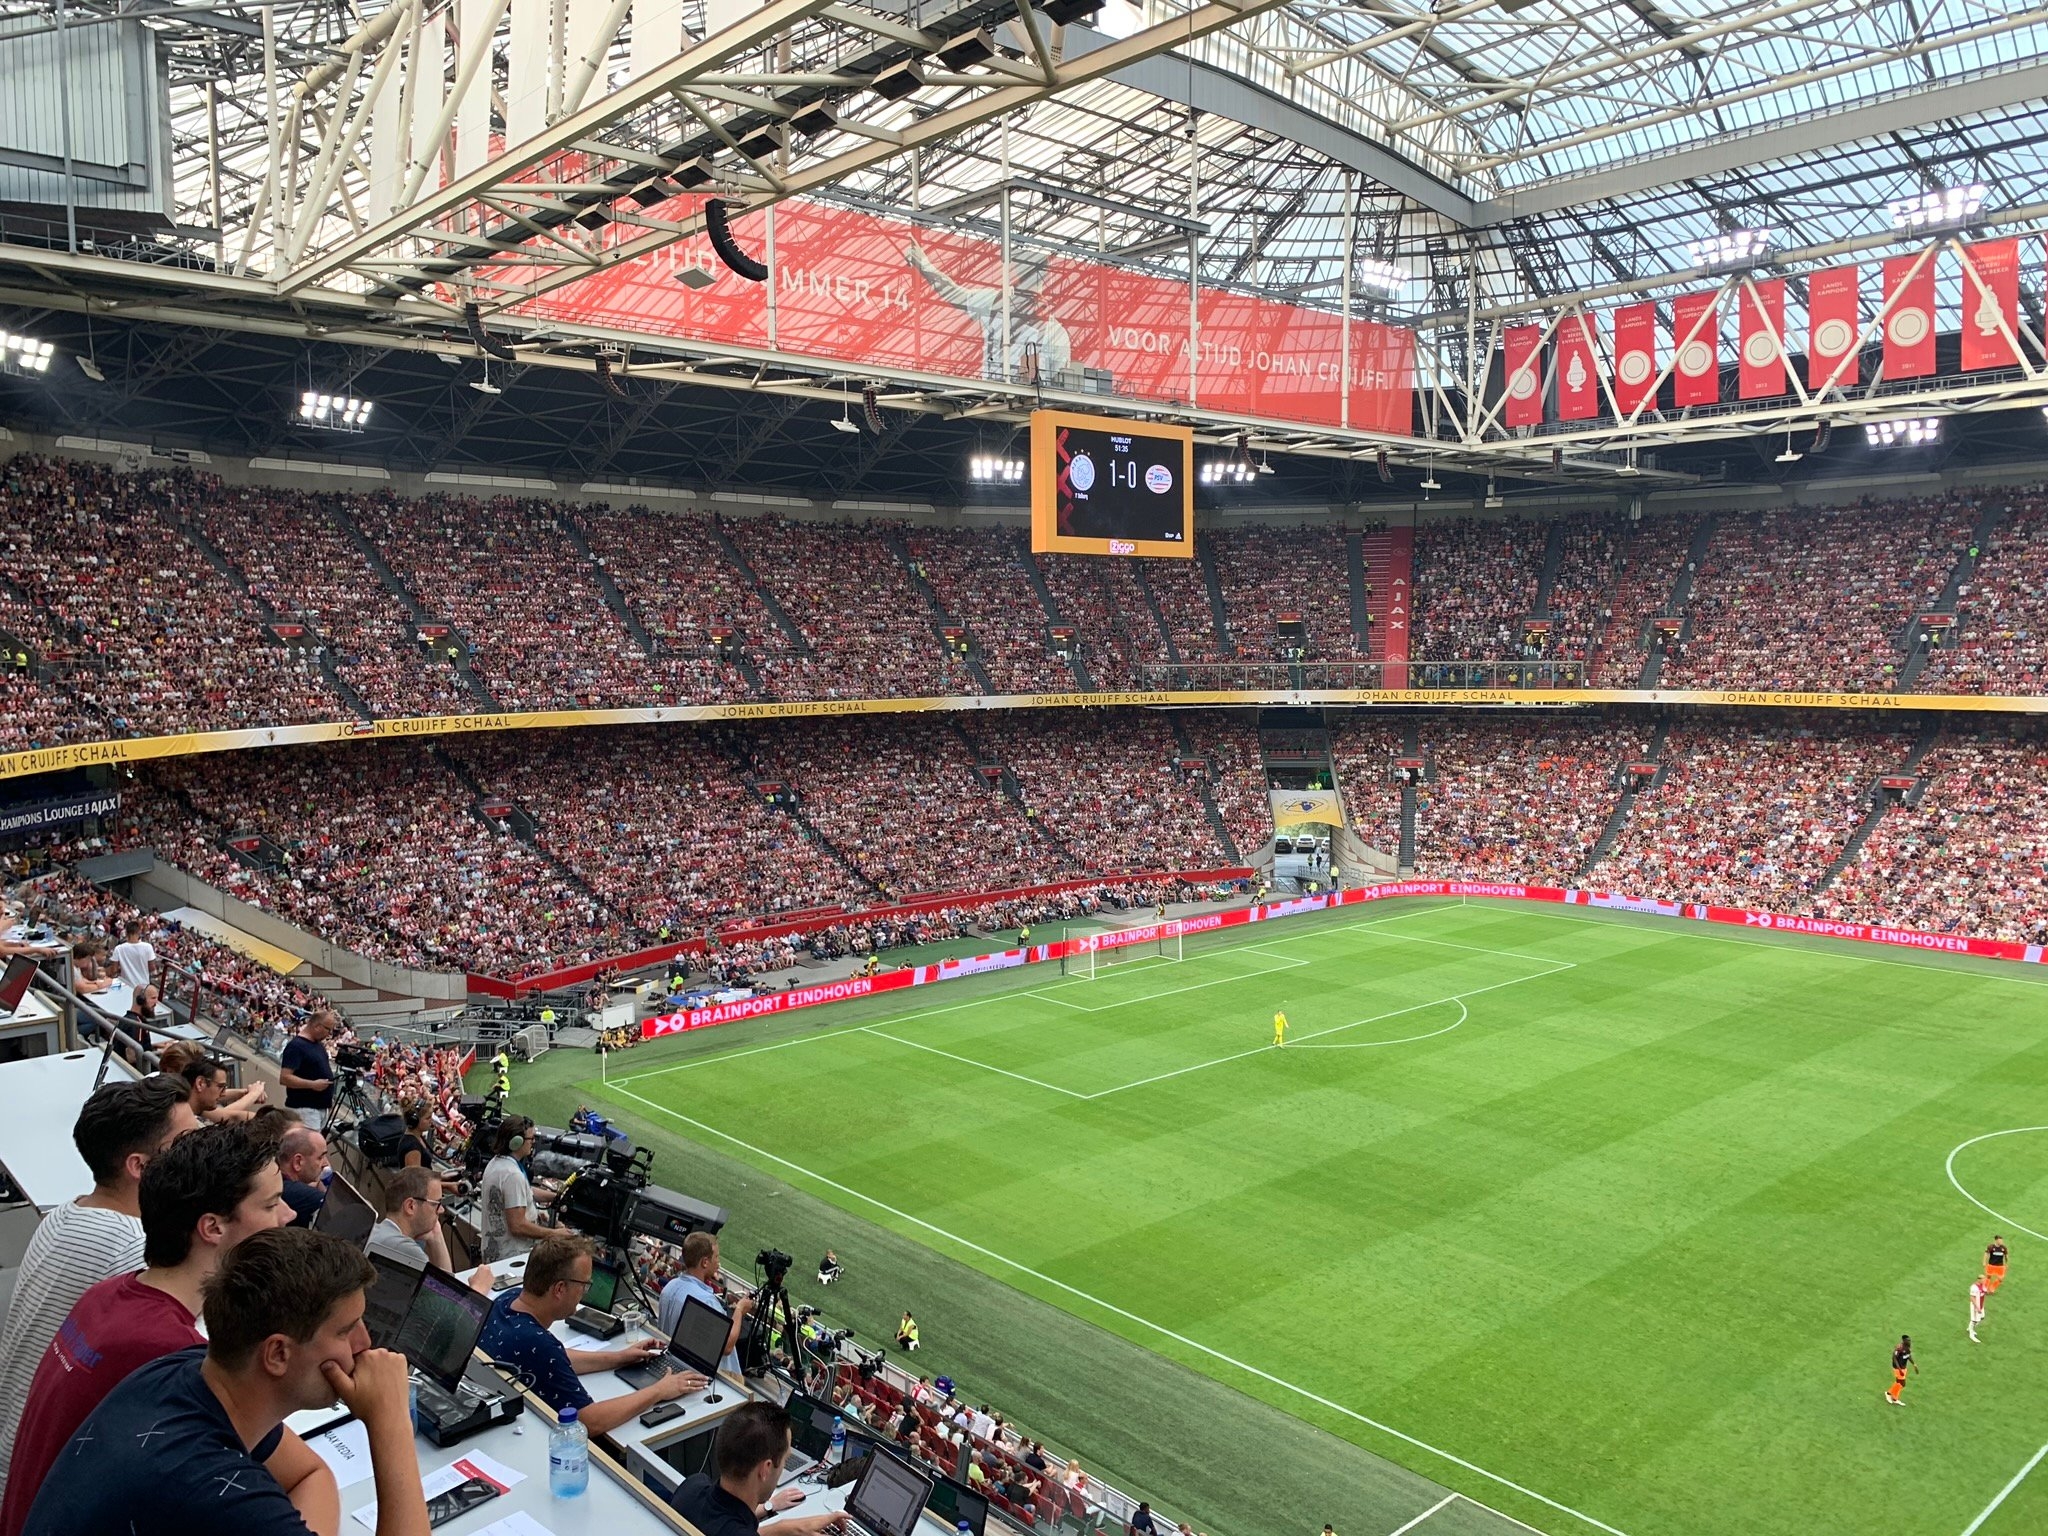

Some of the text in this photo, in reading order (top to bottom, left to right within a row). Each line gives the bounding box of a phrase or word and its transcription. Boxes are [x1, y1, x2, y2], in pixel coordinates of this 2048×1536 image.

[1108, 324, 1170, 356] VOOR
[1248, 351, 1311, 378] JOHAN
[1390, 578, 1406, 629] AJAX
[1032, 693, 1170, 705] JOHAN CRUIJFF SCHAAL
[1356, 691, 1514, 700] JOHAN CRUIJFF SCHAAL
[1721, 693, 1901, 706] JOHAN CRUIJFF SCHAAL
[722, 702, 867, 717] JOHAN CRUIJFF SCHAAL
[337, 723, 385, 737] JON
[392, 718, 447, 734] CRUIJFF
[454, 715, 511, 729] SCHAAL
[21, 750, 68, 771] CRUIJFF
[73, 743, 127, 763] SCHAAL
[91, 797, 116, 816] AJAX
[1381, 883, 1526, 897] BRAINPORT EINDHOVEN
[1776, 917, 1969, 951] BRAINPORT EINDHOVEN
[690, 979, 872, 1026] BRAINPORT EINDHOVEN
